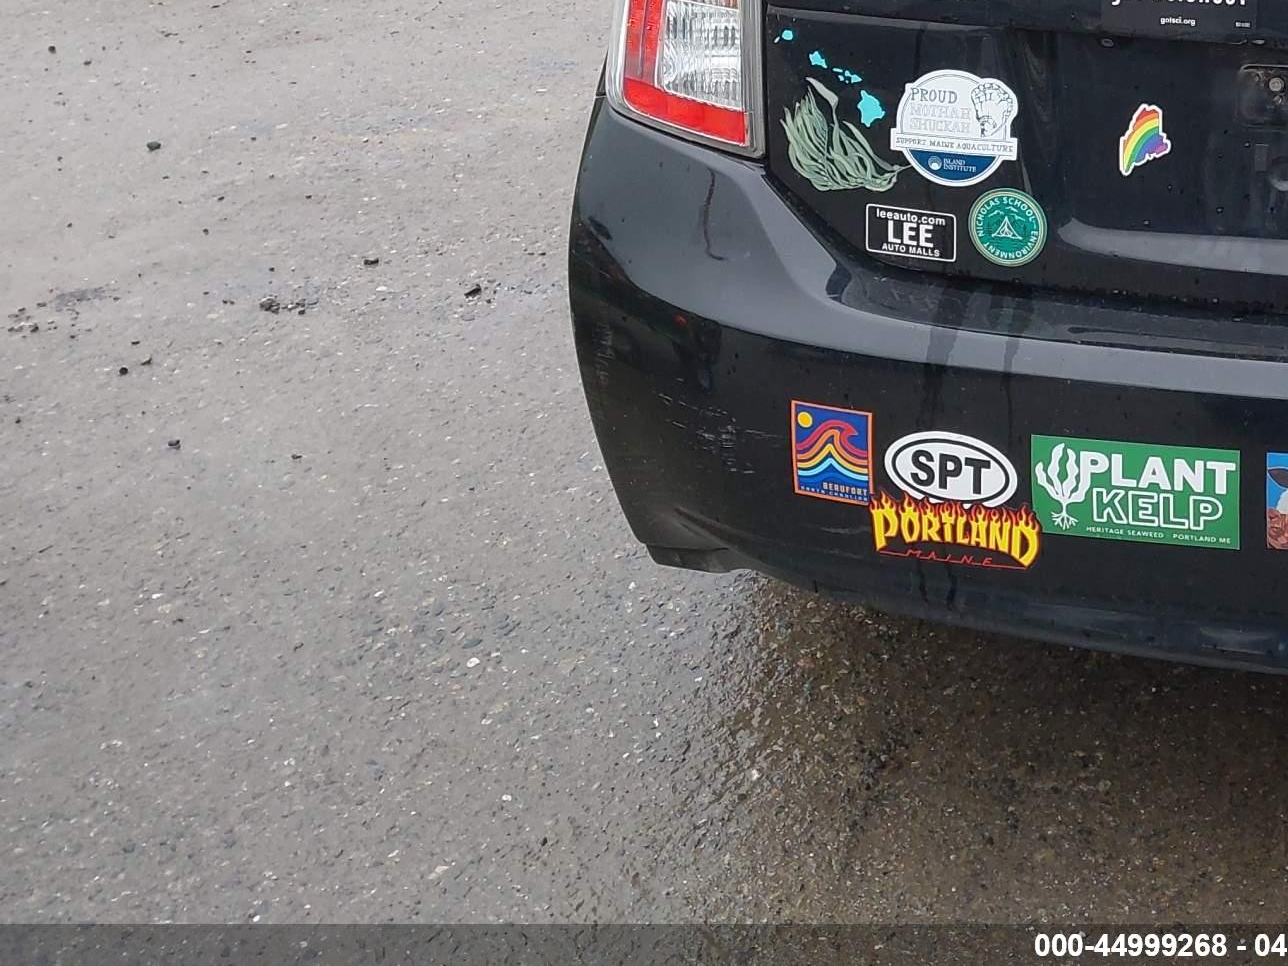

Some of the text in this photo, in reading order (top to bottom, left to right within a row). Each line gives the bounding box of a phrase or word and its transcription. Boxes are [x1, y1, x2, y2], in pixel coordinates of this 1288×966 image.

[910, 87, 958, 104] PROUD
[896, 137, 1014, 153] SUPPORT MAINE AQUACULTURE
[943, 163, 977, 173] INSTITUTE
[876, 208, 946, 226] leeauto.com
[976, 197, 1036, 237] NICHOLAS SCHOOL
[887, 221, 934, 248] LEE
[881, 243, 940, 257] AUTO MALLS
[983, 230, 1039, 260] ENVIRONMENT
[910, 449, 991, 495] SPT
[1080, 450, 1236, 495] PLANT
[822, 481, 868, 496] BEAUFORT
[1092, 487, 1223, 531] KELP
[868, 491, 1040, 567] PORTLAND
[1086, 526, 1124, 535] HERITAGE
[1127, 529, 1164, 539] SEAWEED
[1172, 533, 1217, 543] PORTLAND
[906, 548, 993, 567] MAINE
